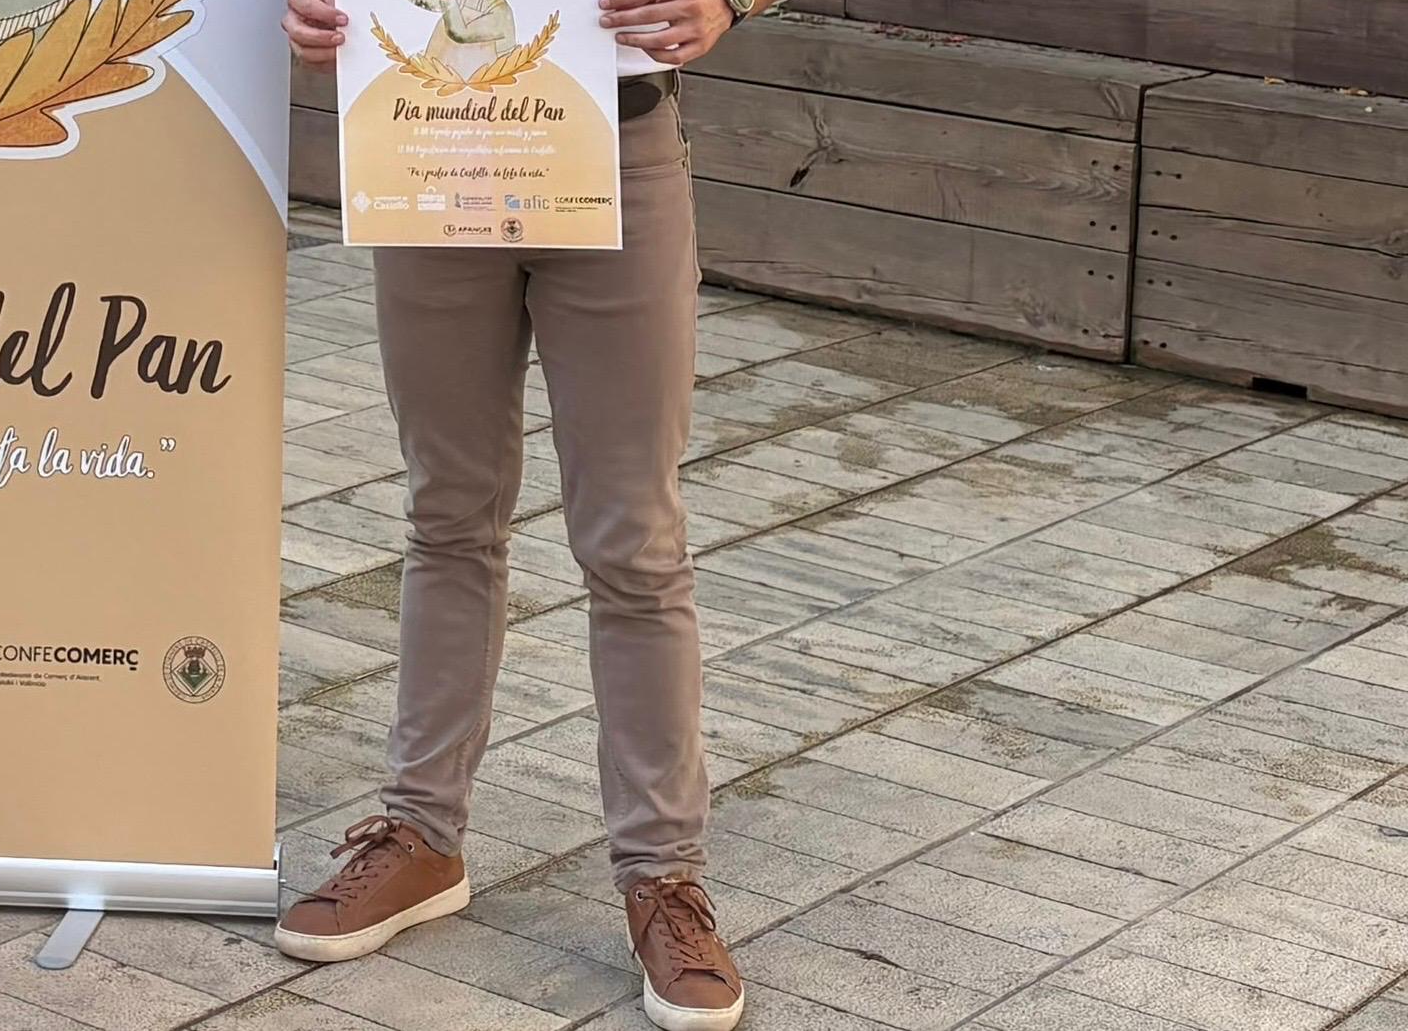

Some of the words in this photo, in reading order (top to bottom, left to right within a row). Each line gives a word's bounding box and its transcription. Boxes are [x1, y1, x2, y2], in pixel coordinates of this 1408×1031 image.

[392, 97, 422, 121] Día
[425, 96, 498, 122] mundial
[500, 96, 530, 122] del
[533, 98, 566, 123] Pan
[90, 295, 232, 400] Pan
[38, 427, 74, 478] la
